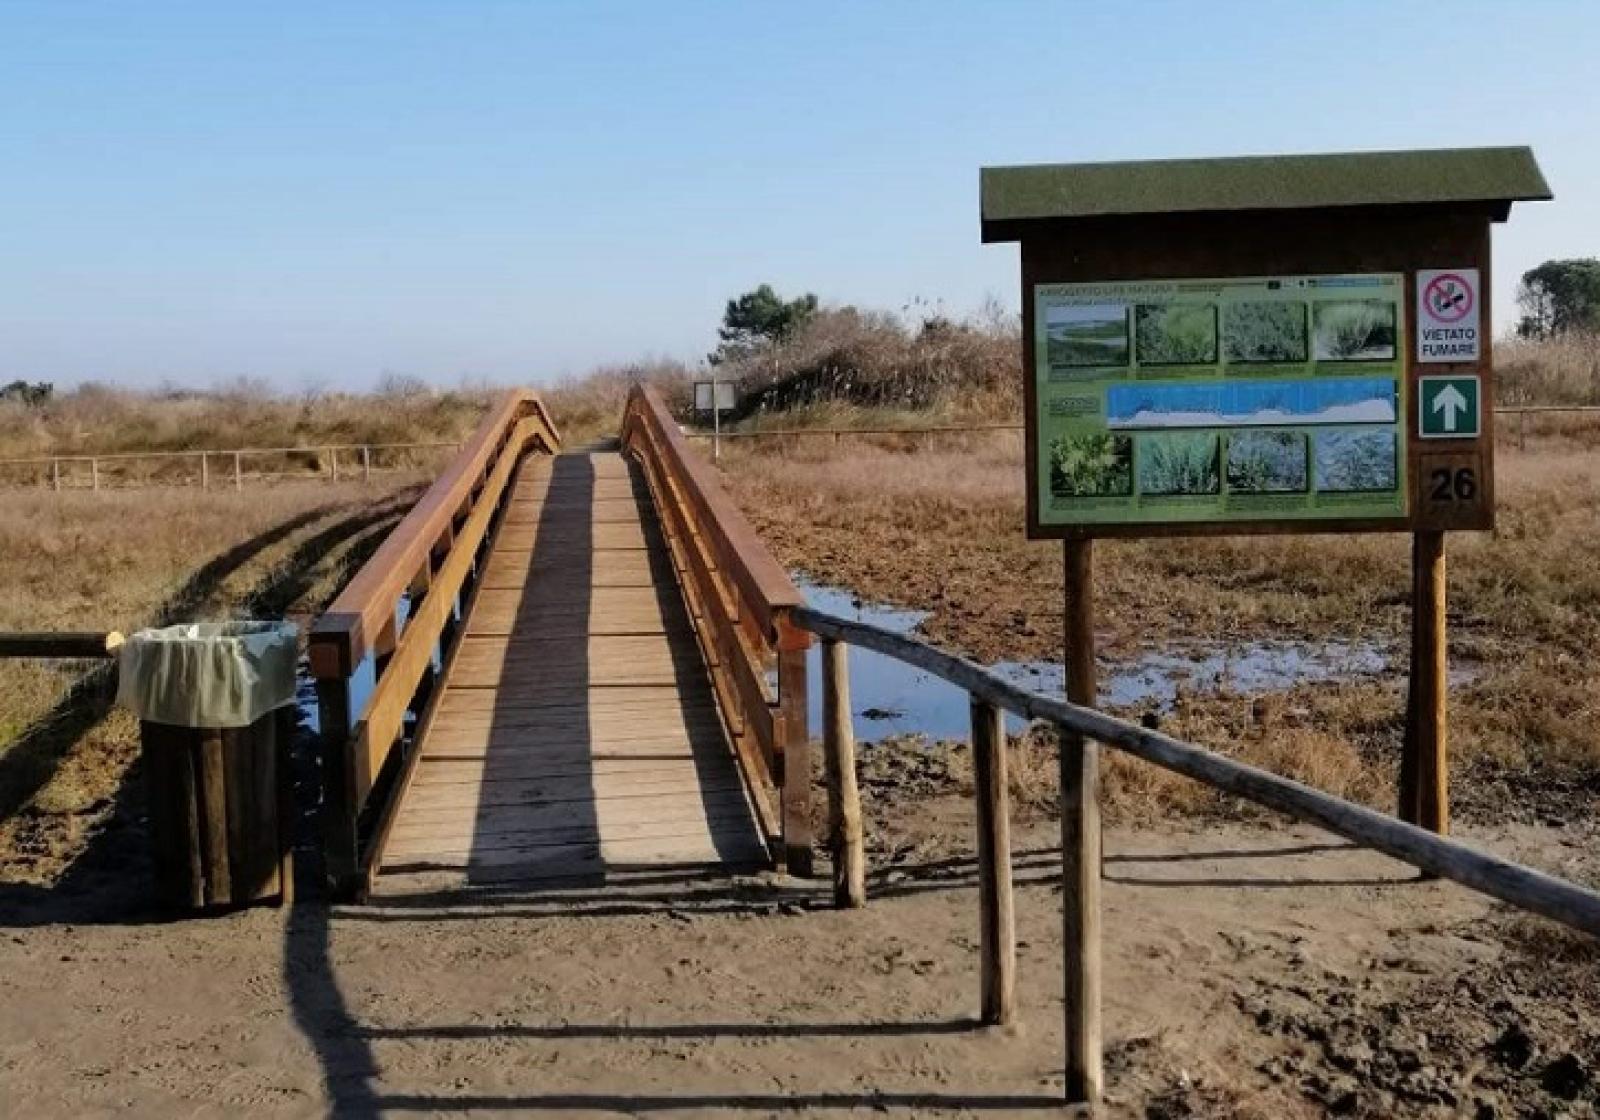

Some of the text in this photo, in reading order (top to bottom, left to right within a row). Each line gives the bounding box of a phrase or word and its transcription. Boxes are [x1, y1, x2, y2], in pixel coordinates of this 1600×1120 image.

[1422, 328, 1475, 341] VIETATO
[1422, 343, 1475, 357] FUMARE
[1431, 467, 1476, 500] 26
